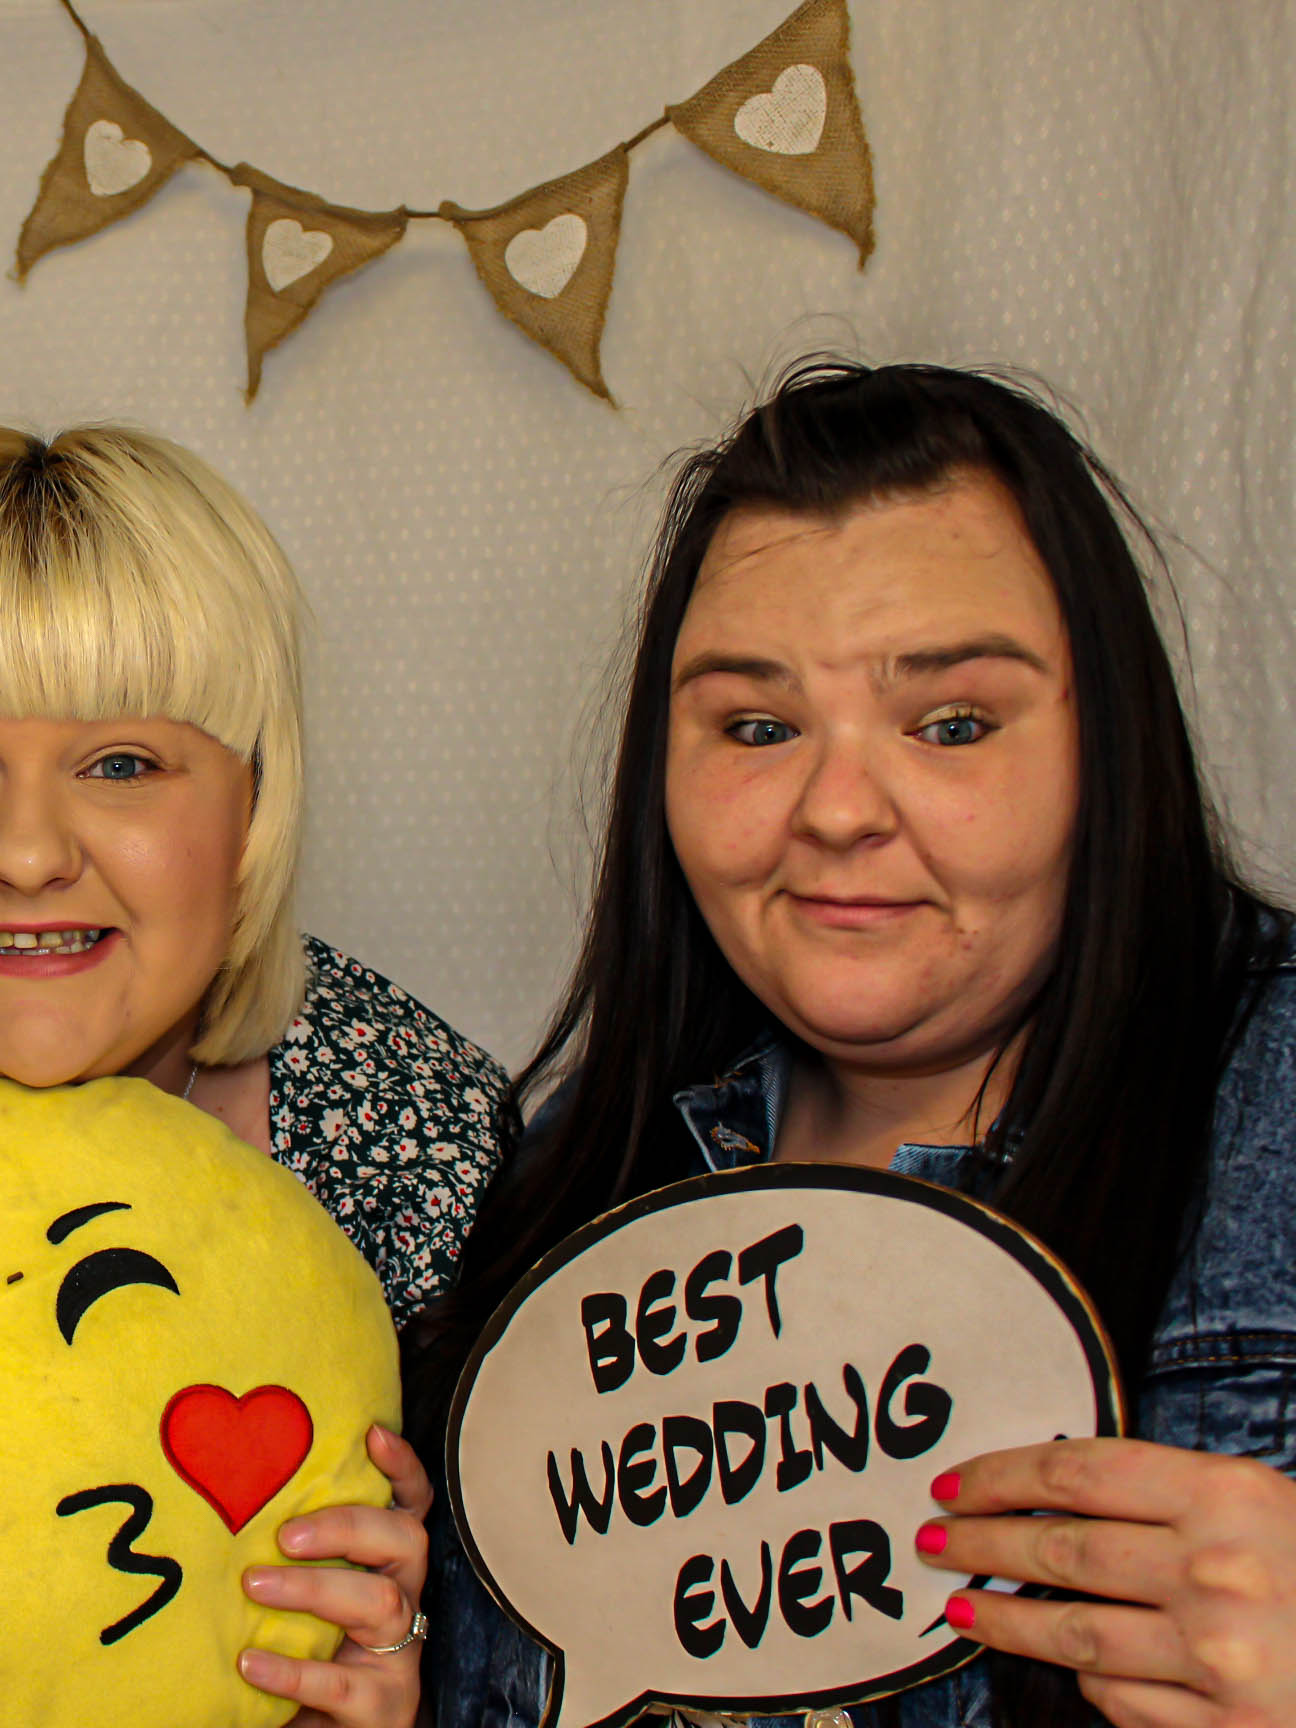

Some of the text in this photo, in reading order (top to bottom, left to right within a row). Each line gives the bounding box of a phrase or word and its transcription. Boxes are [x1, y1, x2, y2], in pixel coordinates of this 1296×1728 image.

[581, 1223, 805, 1394] BEST
[547, 1343, 952, 1545] WEDDING
[674, 1519, 904, 1659] EVER
